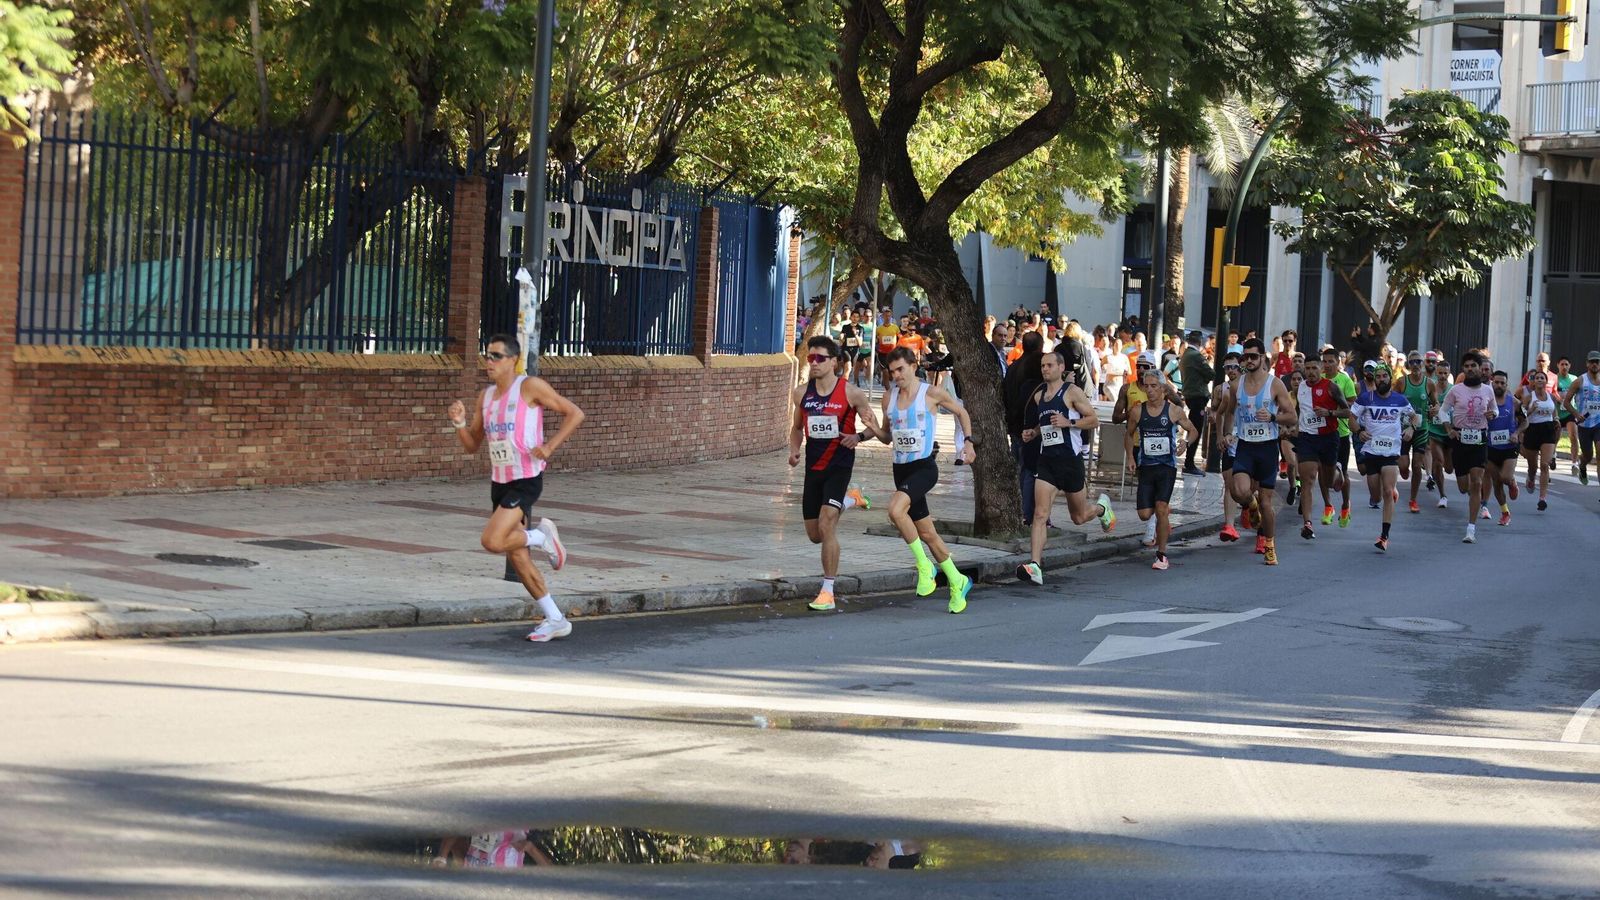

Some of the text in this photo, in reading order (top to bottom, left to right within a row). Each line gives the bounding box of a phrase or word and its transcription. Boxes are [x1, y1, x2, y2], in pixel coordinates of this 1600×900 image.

[1450, 58, 1495, 70] CORNER VIP
[1450, 70, 1494, 81] MALAGUISTA
[1368, 408, 1399, 420] VAS
[811, 424, 832, 432] 694
[1247, 428, 1264, 436] 870
[897, 437, 916, 445] 330
[1150, 443, 1162, 451] 24
